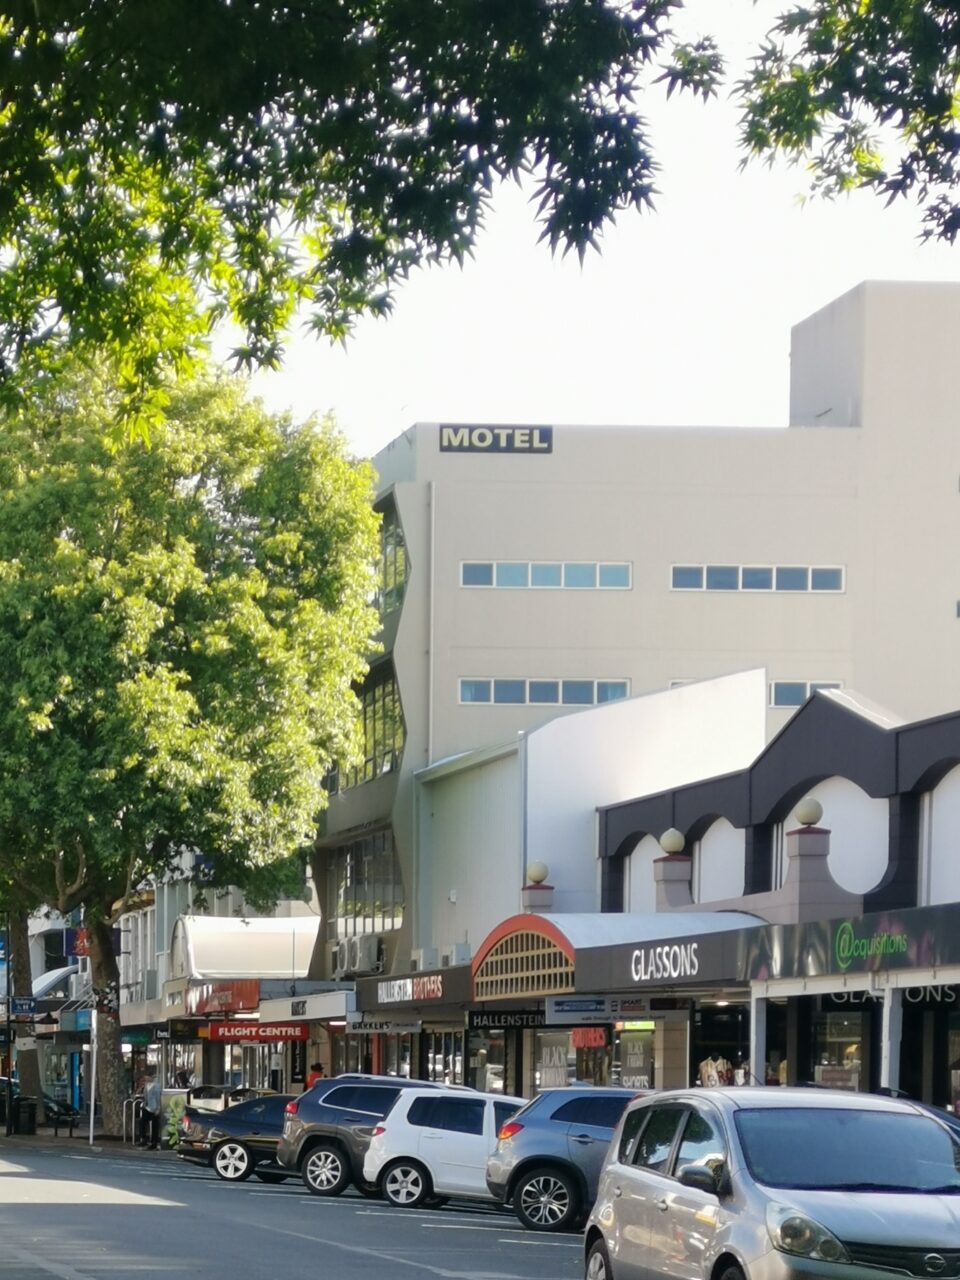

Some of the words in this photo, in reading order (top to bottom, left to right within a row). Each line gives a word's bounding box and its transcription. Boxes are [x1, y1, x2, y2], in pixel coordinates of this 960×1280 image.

[442, 427, 548, 448] MOTEL
[631, 943, 699, 981] GLASSONS
[473, 1014, 545, 1027] HALLENSTEIN
[218, 1027, 258, 1036] FLIGHT
[259, 1027, 302, 1036] CENTRE
